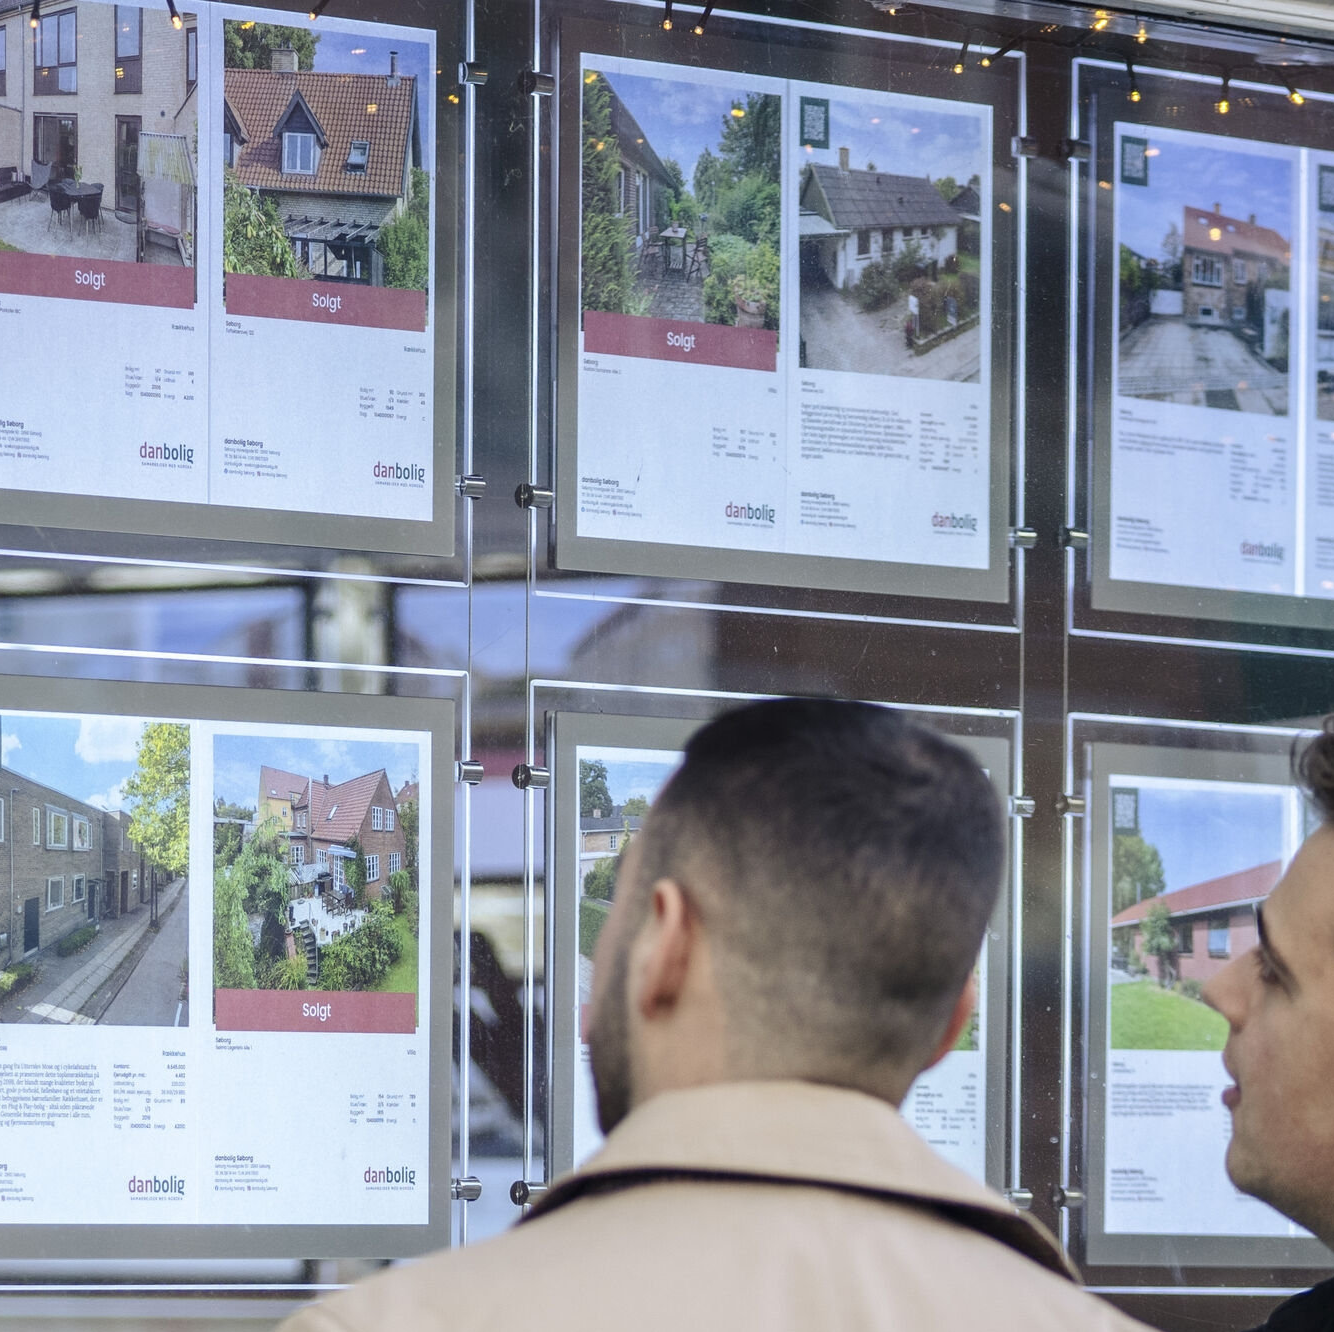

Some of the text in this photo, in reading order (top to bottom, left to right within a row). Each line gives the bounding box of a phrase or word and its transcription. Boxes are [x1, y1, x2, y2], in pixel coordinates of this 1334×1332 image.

[75, 270, 106, 290] Solgt
[312, 293, 342, 313] Solgt
[667, 332, 696, 352] Solgt
[140, 442, 194, 464] danbolig
[224, 438, 246, 448] danbolig
[374, 462, 425, 484] danbolig
[725, 502, 775, 523] danbolig
[303, 1003, 332, 1022] Solgt
[128, 1176, 185, 1195] danbolig
[364, 1166, 416, 1185] danbolig
